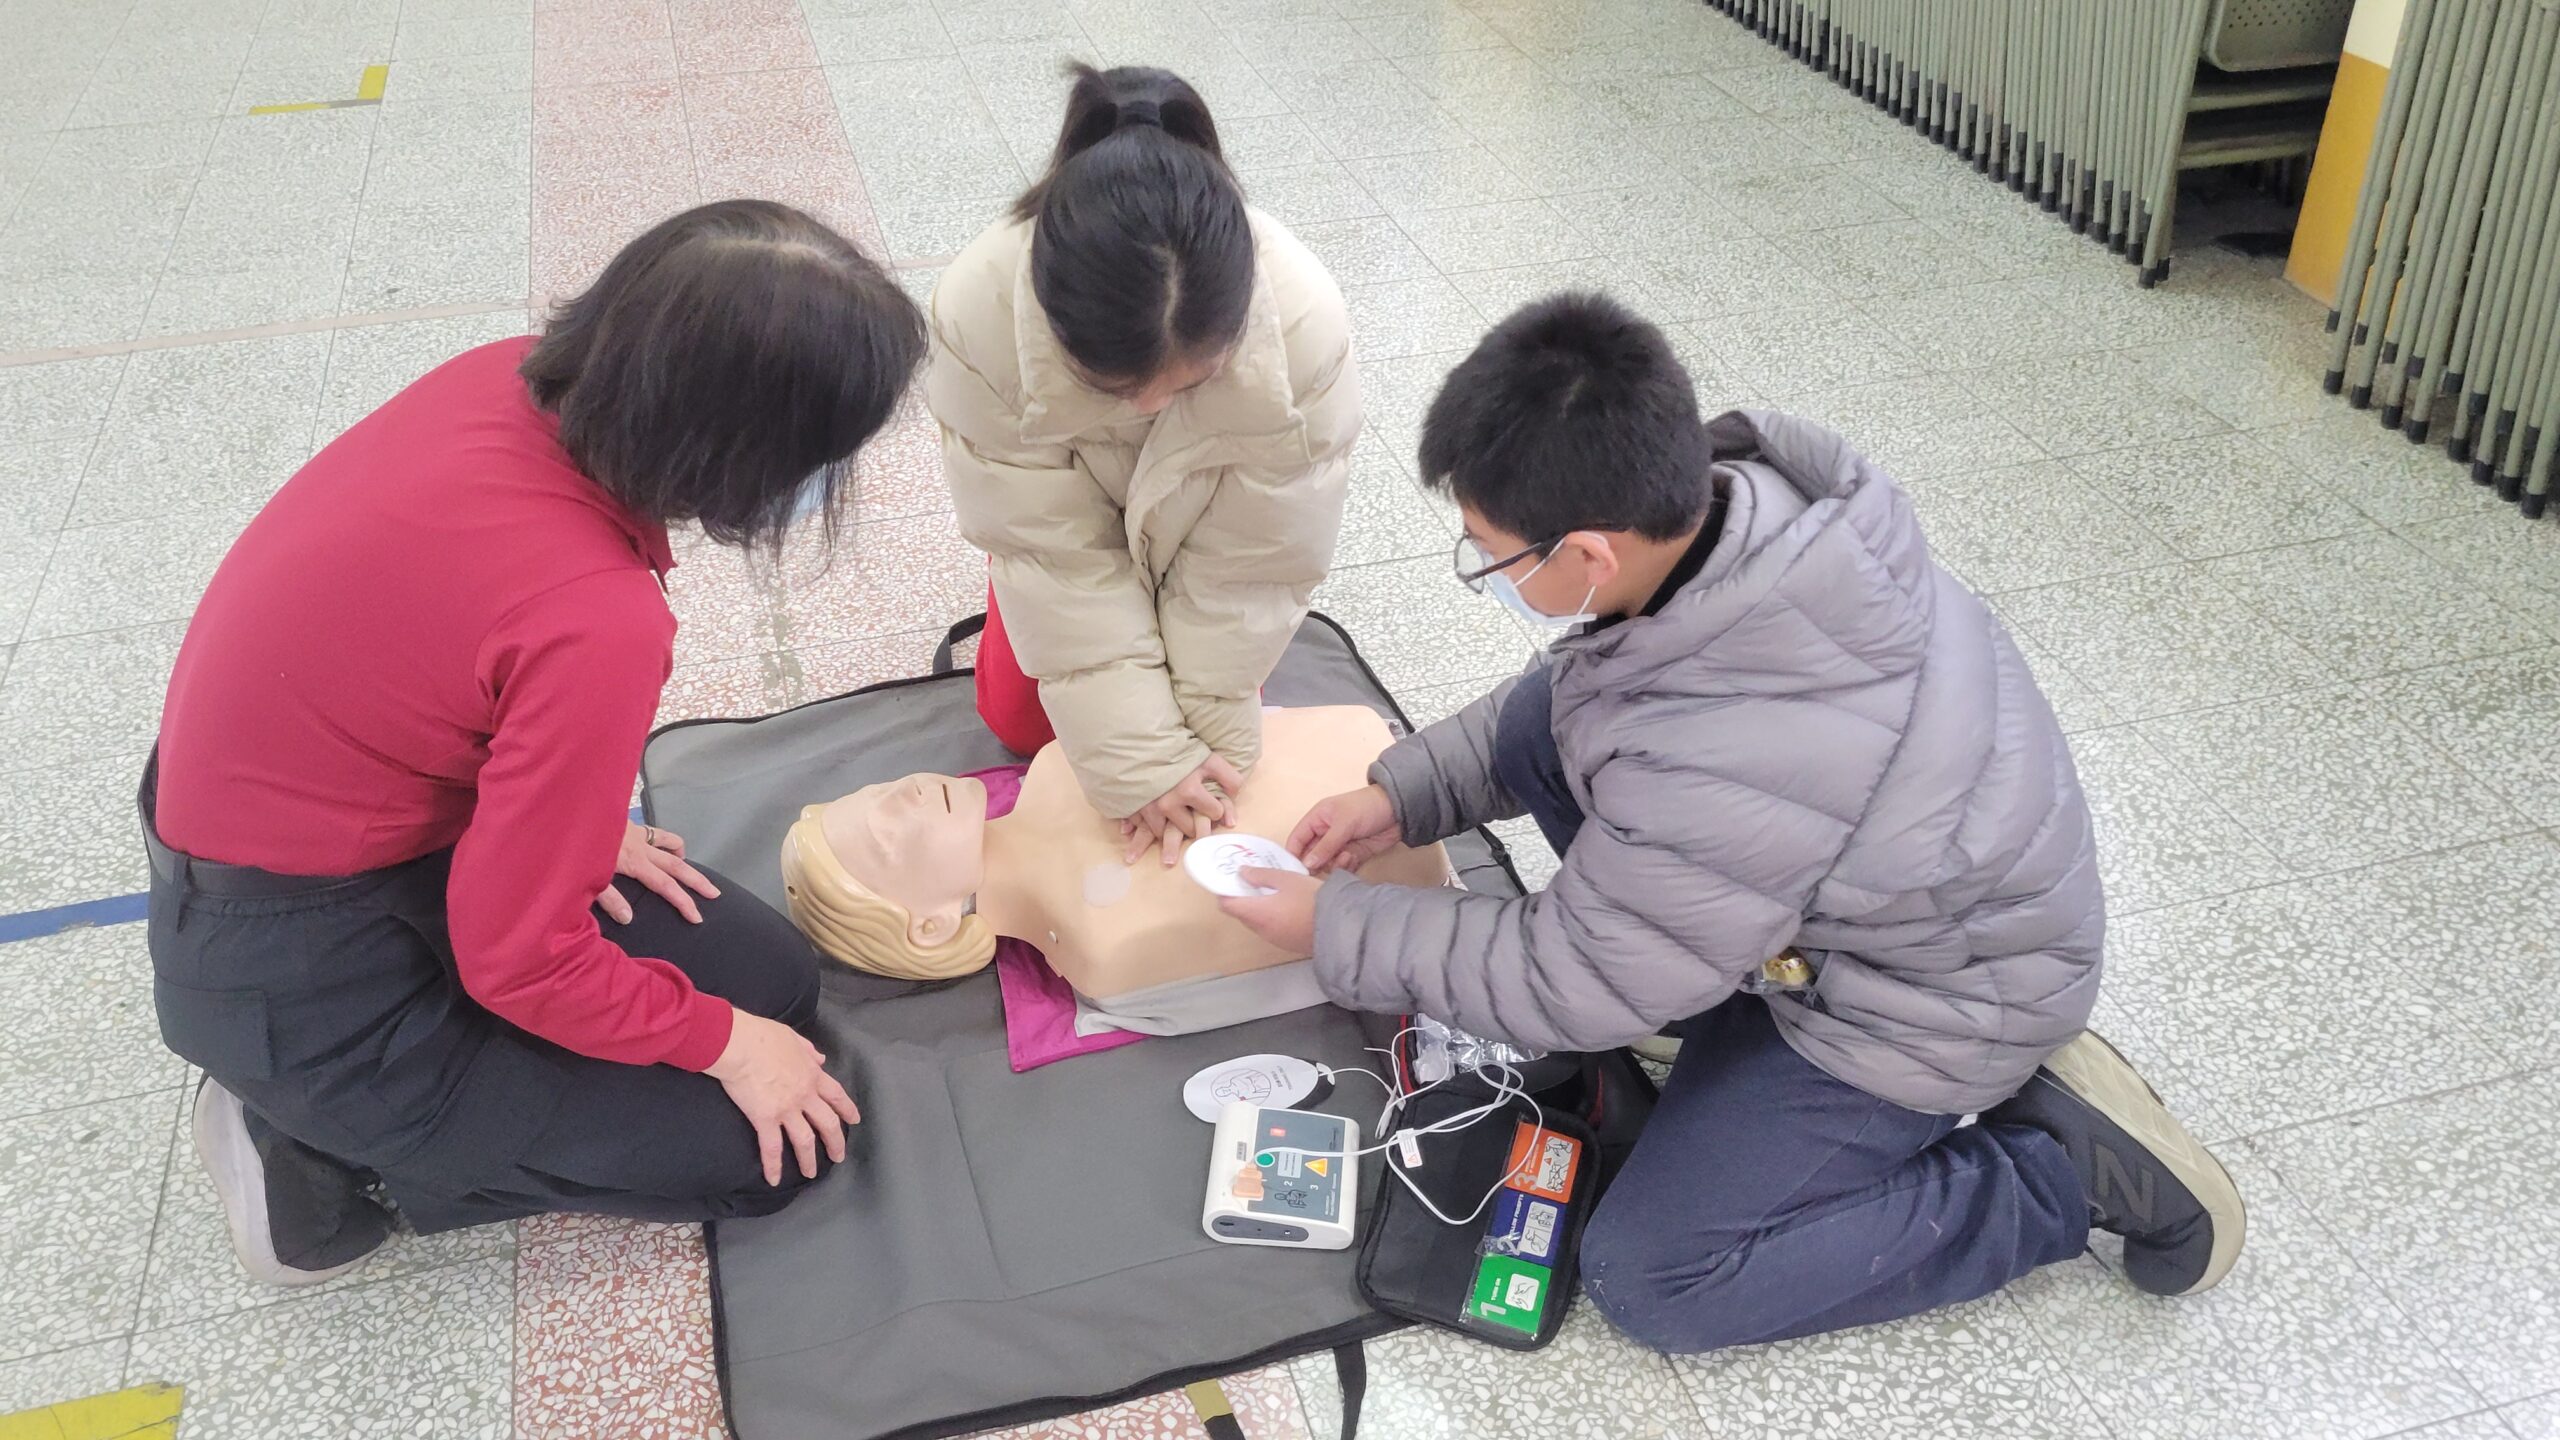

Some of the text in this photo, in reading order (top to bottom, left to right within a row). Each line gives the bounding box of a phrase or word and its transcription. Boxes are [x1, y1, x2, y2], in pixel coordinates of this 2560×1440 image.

[1515, 1172, 1537, 1190] 3
[2094, 1142, 2154, 1224] N
[1497, 1237, 1520, 1256] 2
[1481, 1301, 1507, 1316] 1
